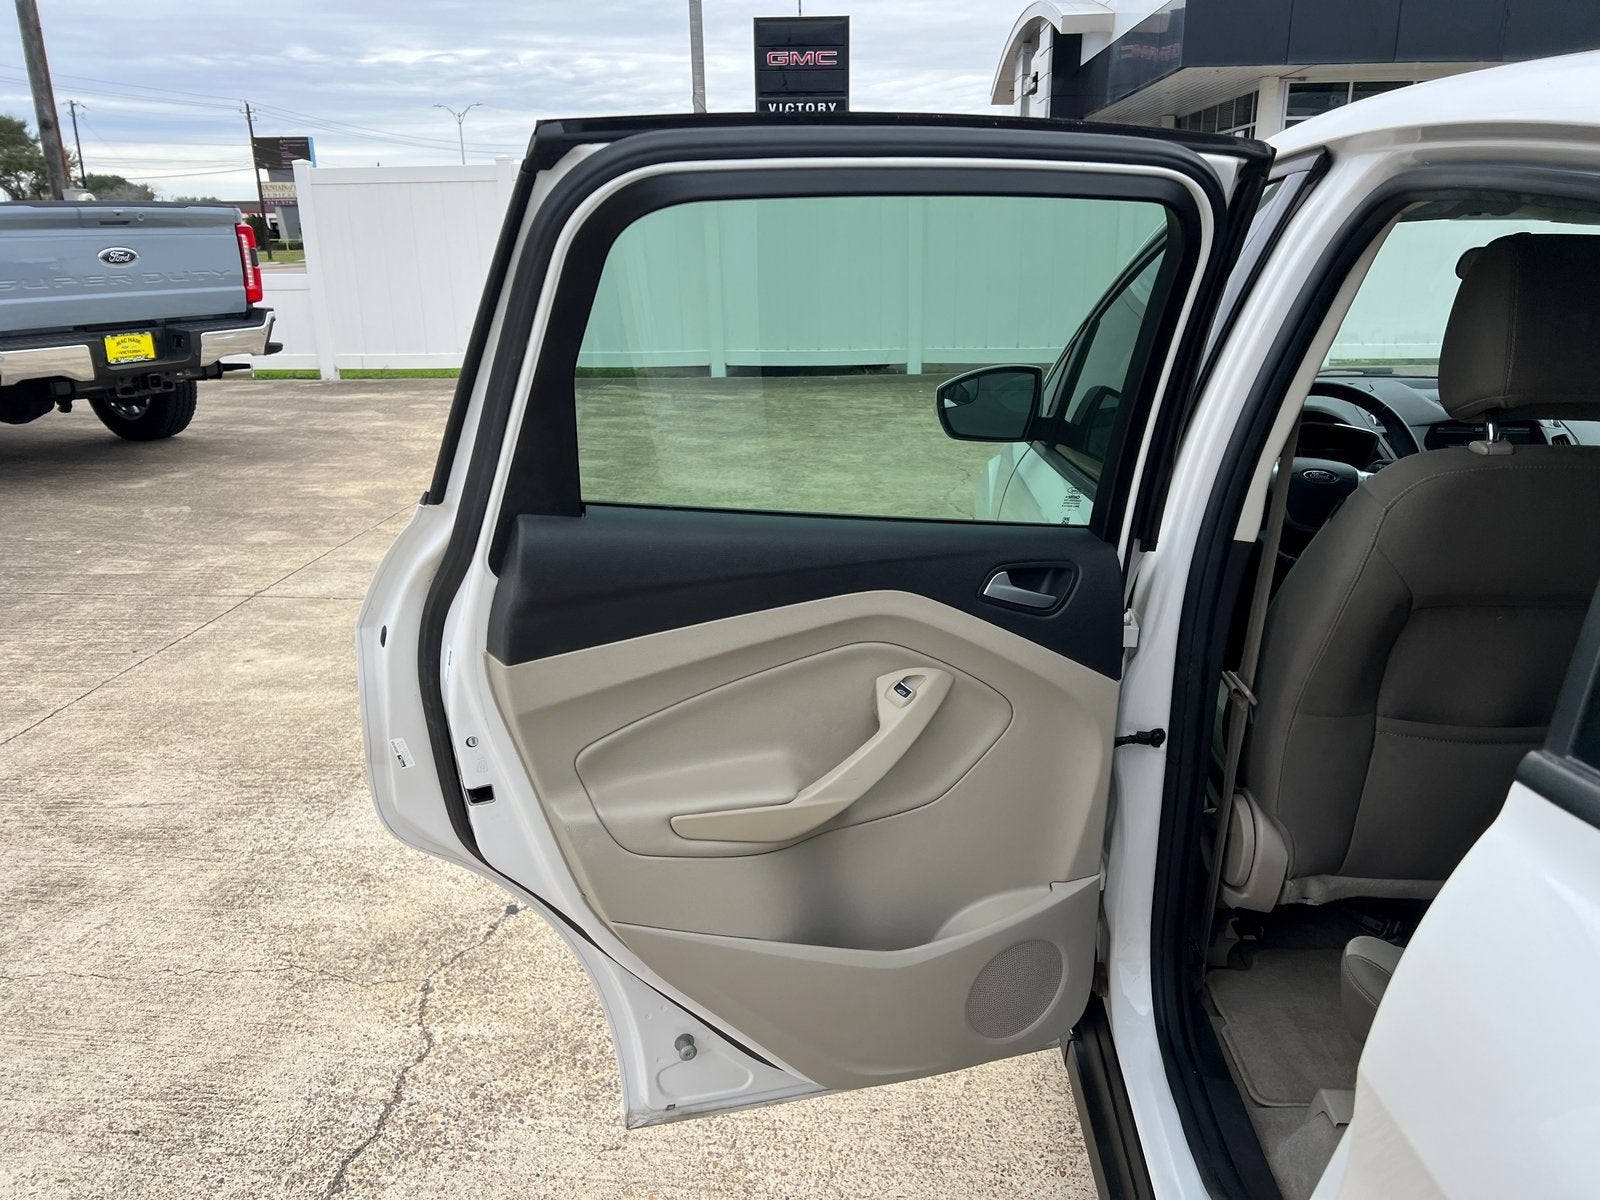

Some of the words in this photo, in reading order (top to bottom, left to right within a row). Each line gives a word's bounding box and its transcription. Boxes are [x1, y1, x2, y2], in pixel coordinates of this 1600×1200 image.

[766, 51, 838, 66] GMC
[767, 102, 837, 113] VICTORY
[109, 251, 131, 262] Ford
[141, 269, 231, 284] DUTY
